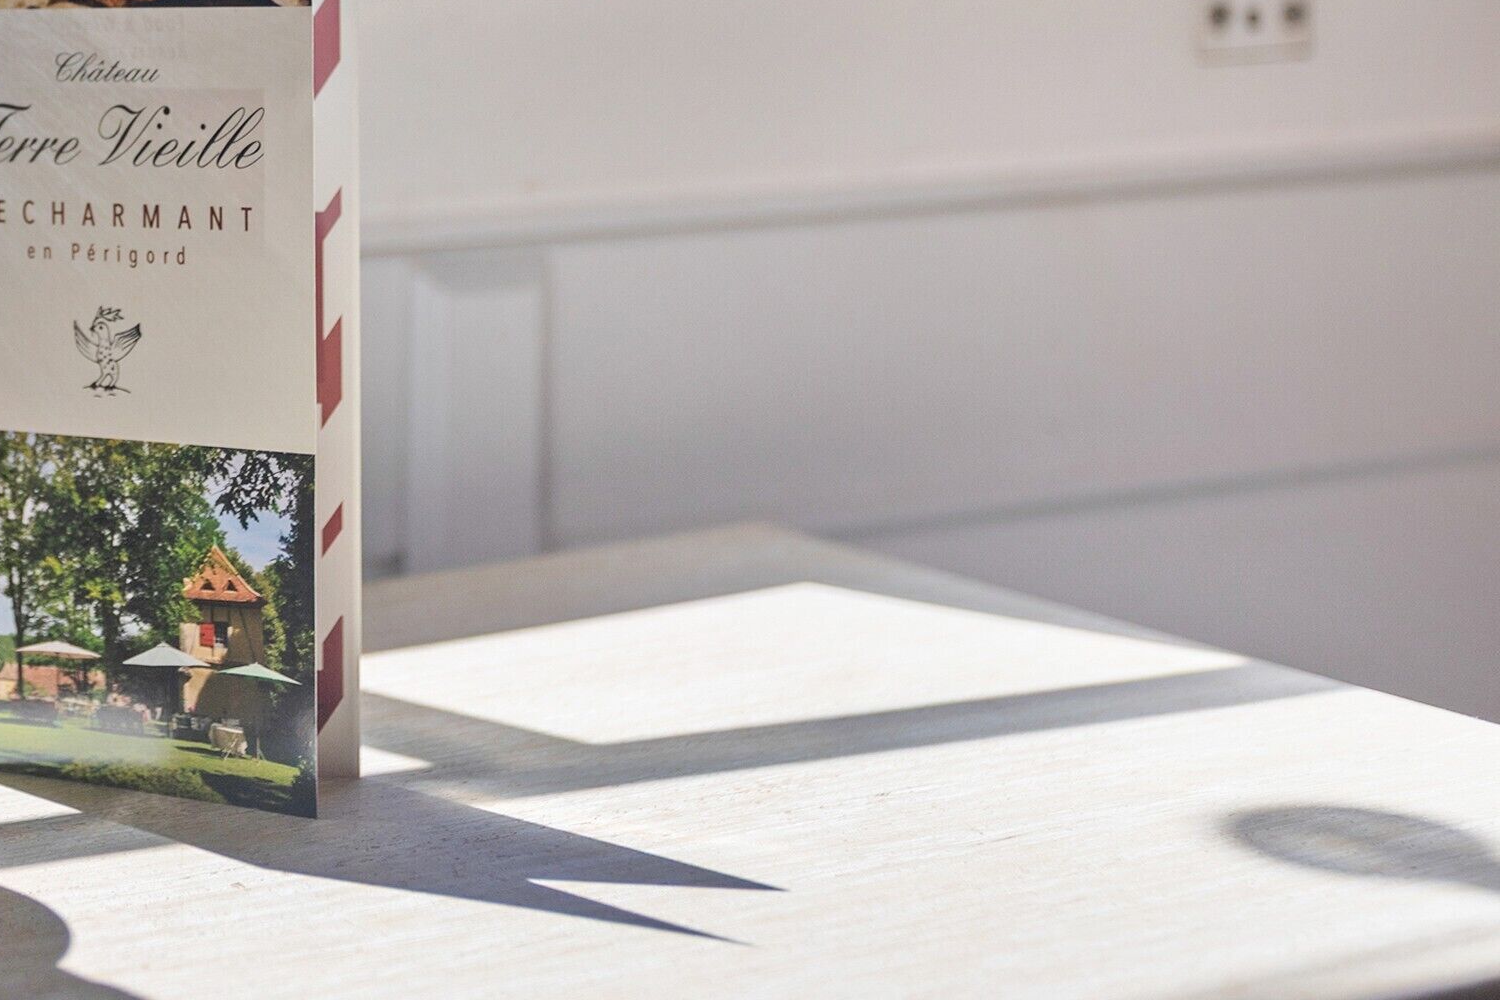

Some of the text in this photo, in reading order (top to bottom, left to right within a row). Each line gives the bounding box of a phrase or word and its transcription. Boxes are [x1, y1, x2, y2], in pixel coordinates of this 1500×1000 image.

[55, 52, 159, 83] Château
[97, 105, 265, 169] Vieille
[27, 243, 187, 268] en Périgord
